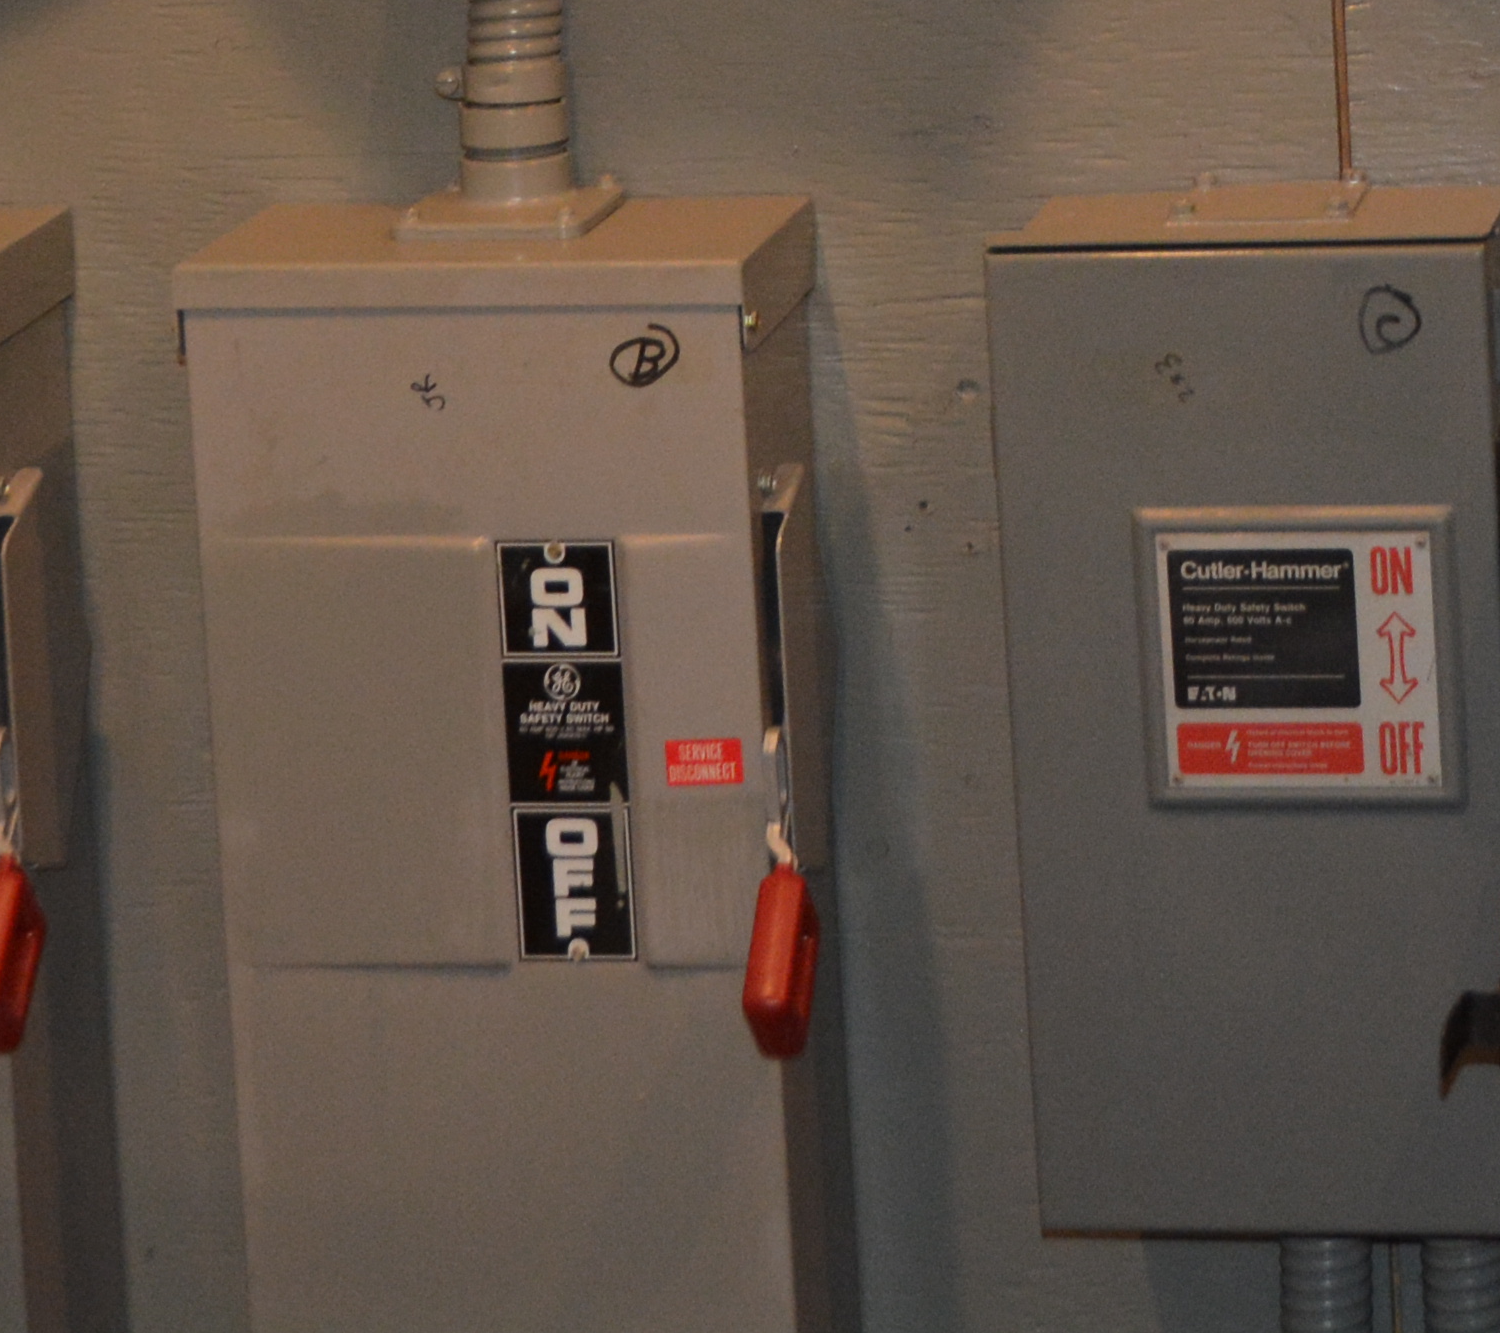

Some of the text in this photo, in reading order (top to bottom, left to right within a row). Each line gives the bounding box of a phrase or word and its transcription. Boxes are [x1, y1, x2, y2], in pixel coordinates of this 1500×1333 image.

[1180, 559, 1344, 581] Cutler-Hammer
[1369, 545, 1415, 596] ON
[530, 567, 588, 649] ON
[1181, 602, 1306, 614] Heavy Duty Safety Switch
[1246, 615, 1272, 625] Volts
[528, 700, 600, 712] HEAVY DUTY
[519, 712, 610, 724] SAFETY SWITCH
[678, 742, 723, 762] SERVICE
[1187, 741, 1221, 750] DANGER
[1320, 740, 1351, 749] BEFORE
[1378, 721, 1426, 775] OFF
[668, 761, 738, 783] DISCONNECT
[545, 817, 599, 939] OFF
